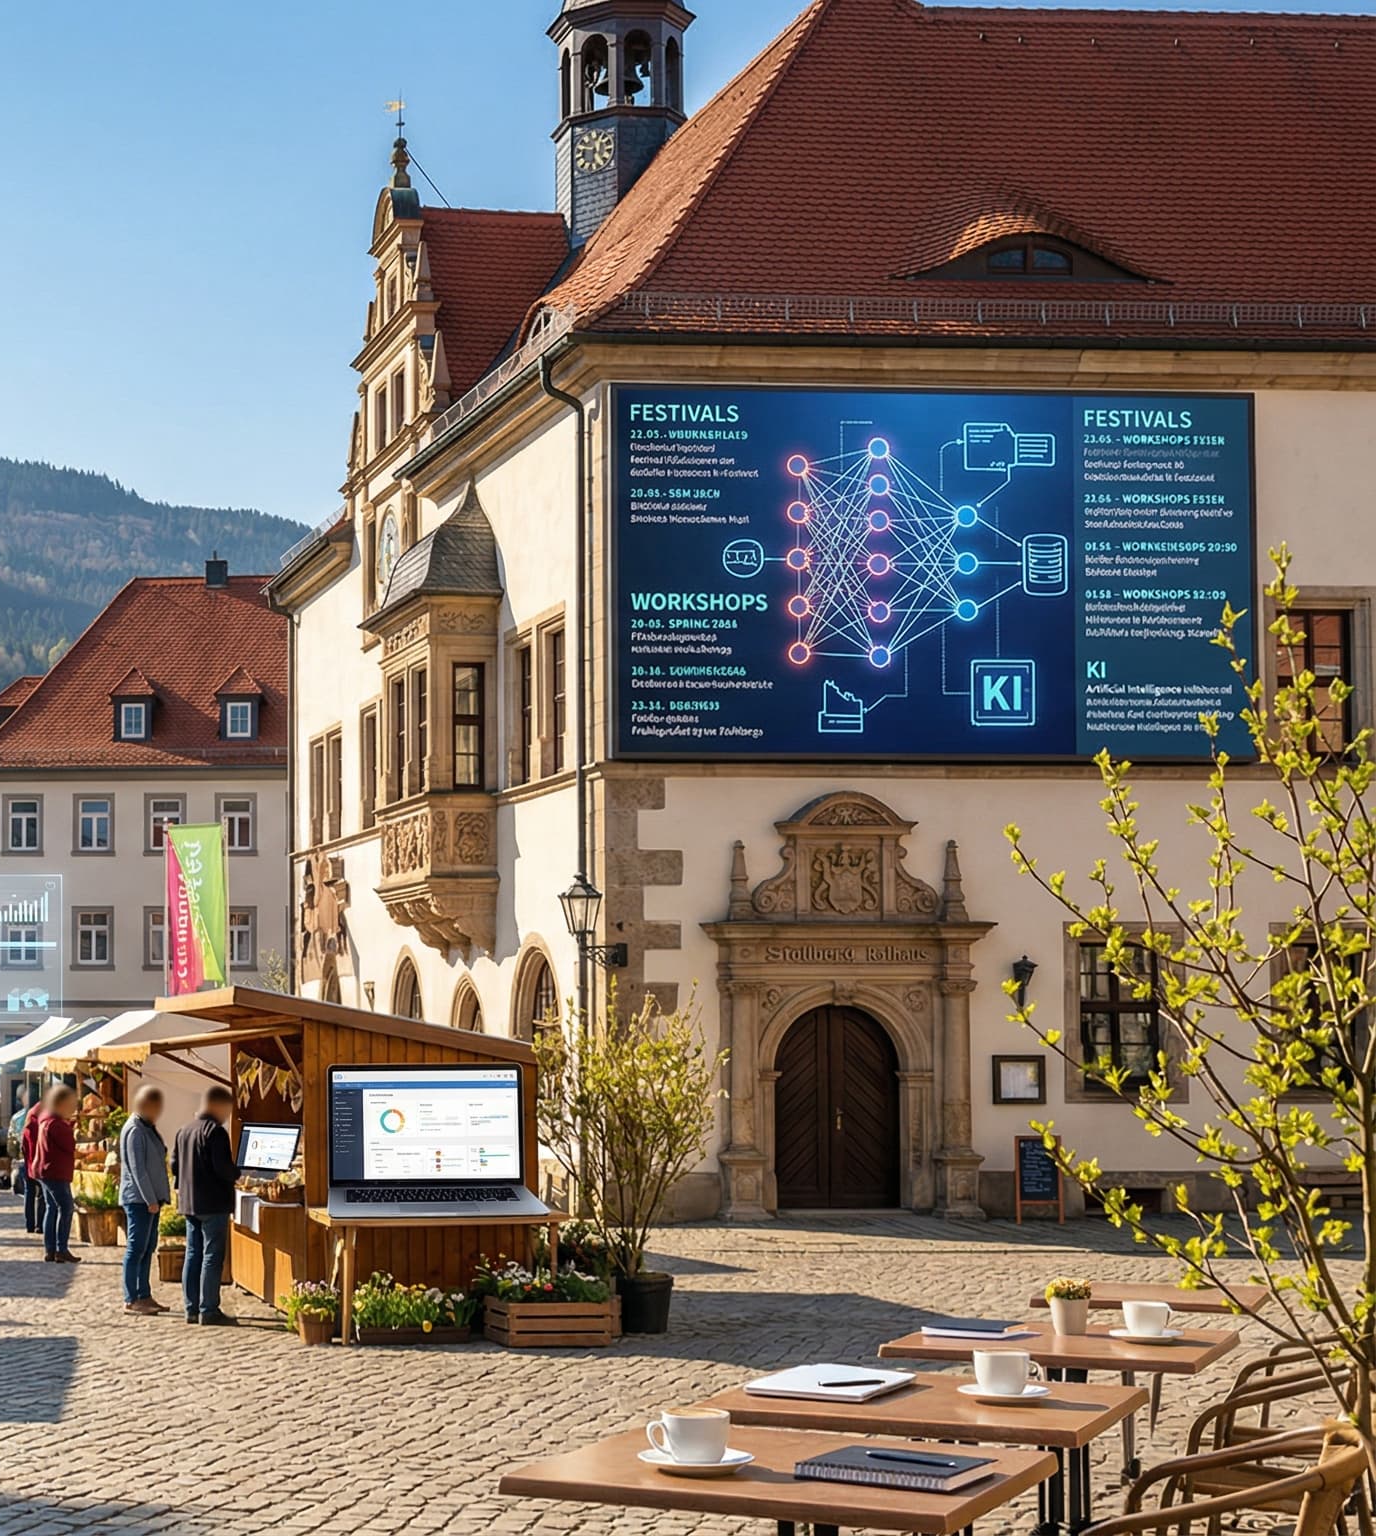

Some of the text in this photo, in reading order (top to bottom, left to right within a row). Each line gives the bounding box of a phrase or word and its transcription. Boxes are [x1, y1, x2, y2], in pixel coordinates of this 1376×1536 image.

[629, 404, 740, 423] FESTIVALS
[1083, 410, 1193, 429] FESTIVALS
[1122, 494, 1191, 505] WORKSHOPS
[630, 592, 768, 612] WORKSHOPS
[1086, 661, 1107, 679] KI
[983, 675, 1023, 711] KI
